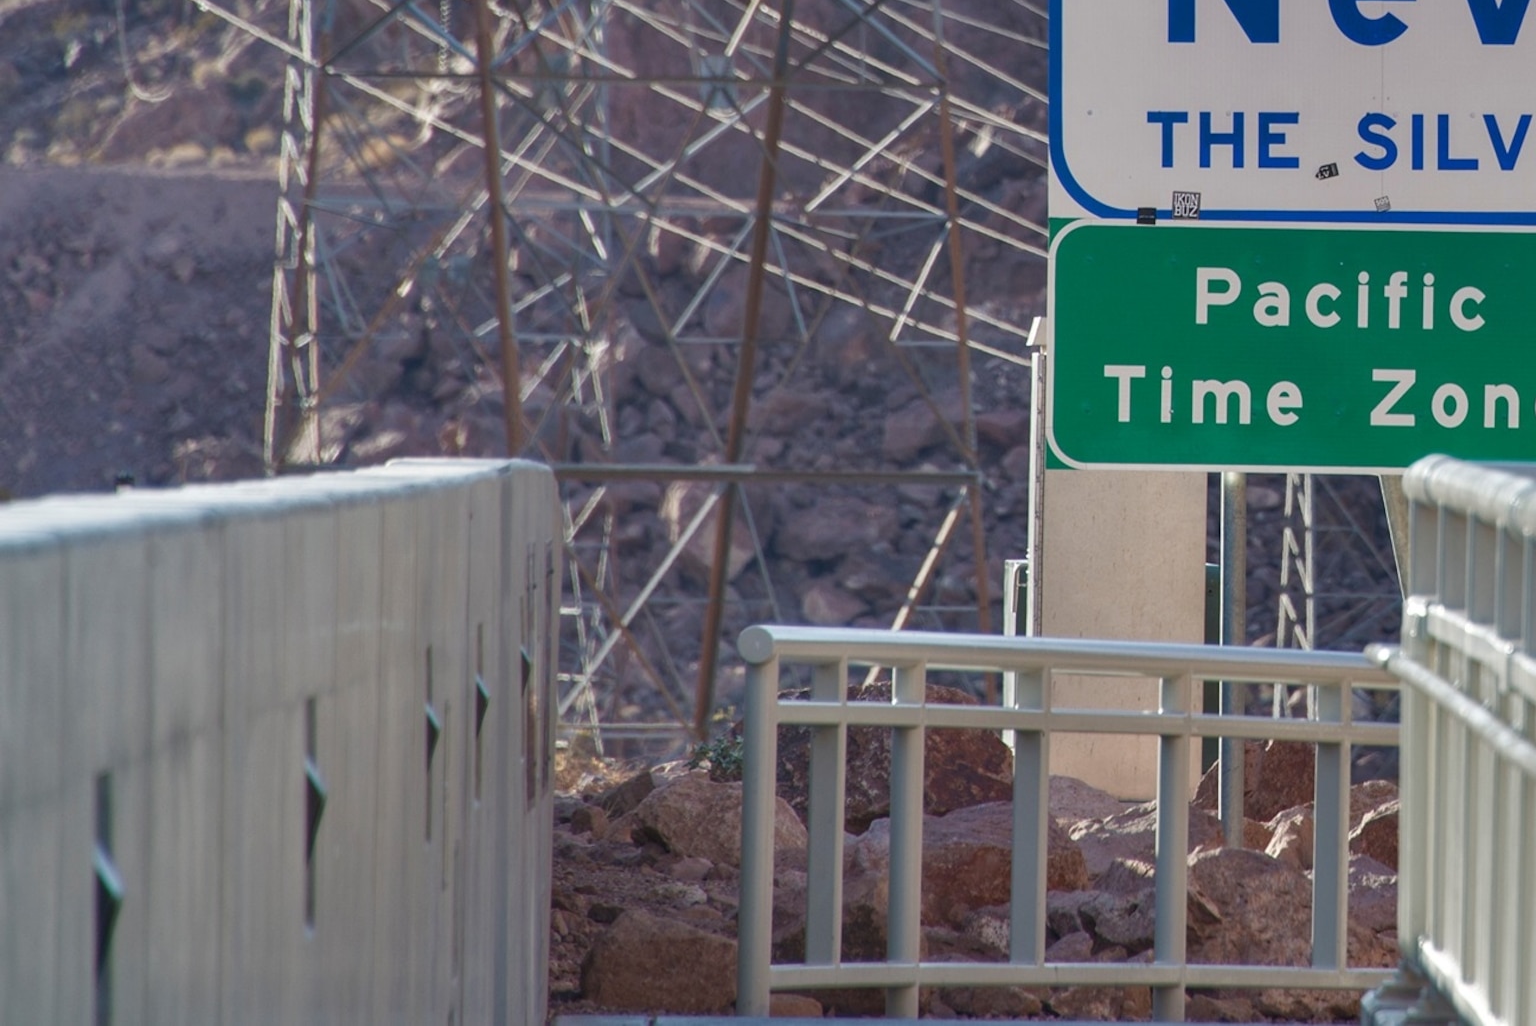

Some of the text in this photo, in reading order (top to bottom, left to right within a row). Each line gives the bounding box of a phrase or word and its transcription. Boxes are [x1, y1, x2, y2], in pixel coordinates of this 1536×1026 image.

[1147, 111, 1299, 168] THE
[1174, 193, 1200, 207] IKON
[1174, 205, 1198, 217] BUZ
[1197, 268, 1485, 330] Pacific
[1105, 366, 1302, 425] Time
